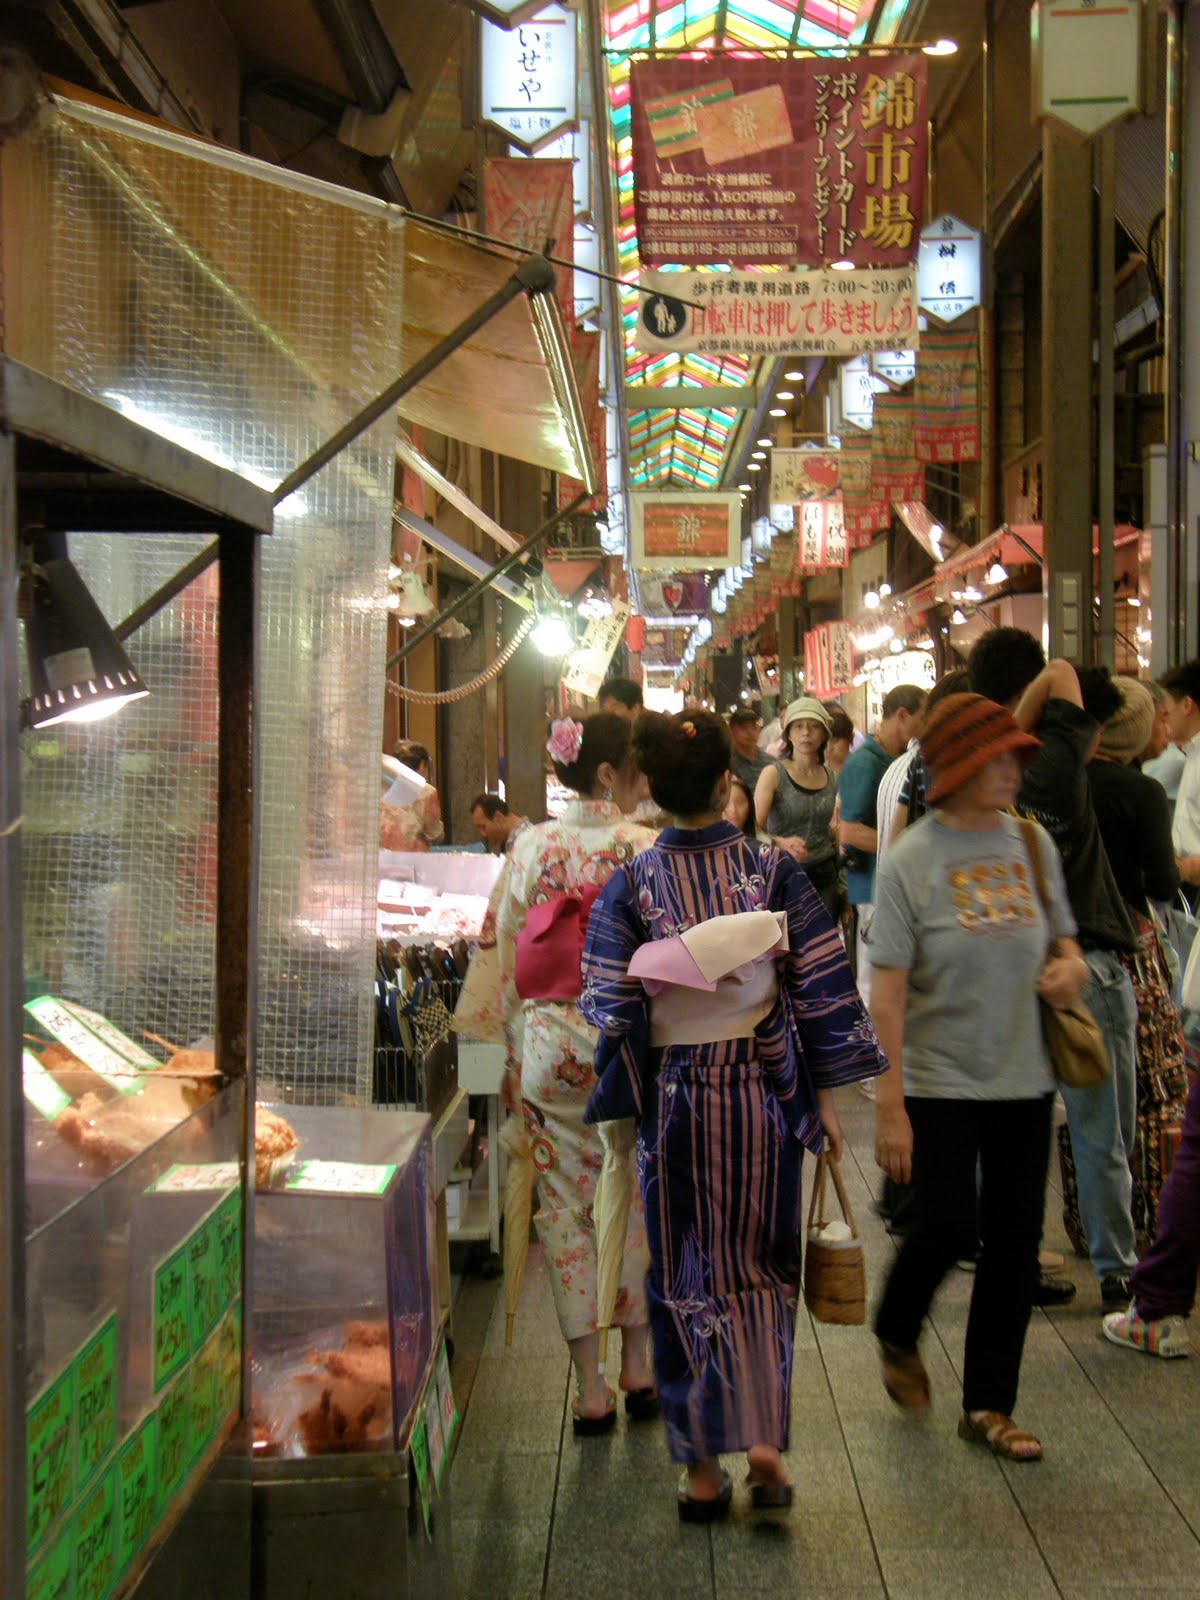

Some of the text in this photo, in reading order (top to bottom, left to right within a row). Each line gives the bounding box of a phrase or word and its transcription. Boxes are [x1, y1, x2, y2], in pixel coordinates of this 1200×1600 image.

[518, 27, 541, 102] いせや
[833, 72, 857, 255] ポイントカード
[860, 72, 916, 248] 錦市場
[691, 280, 811, 297] 歩行者専用道路
[691, 297, 914, 337] 自転車は押して歩きましょう
